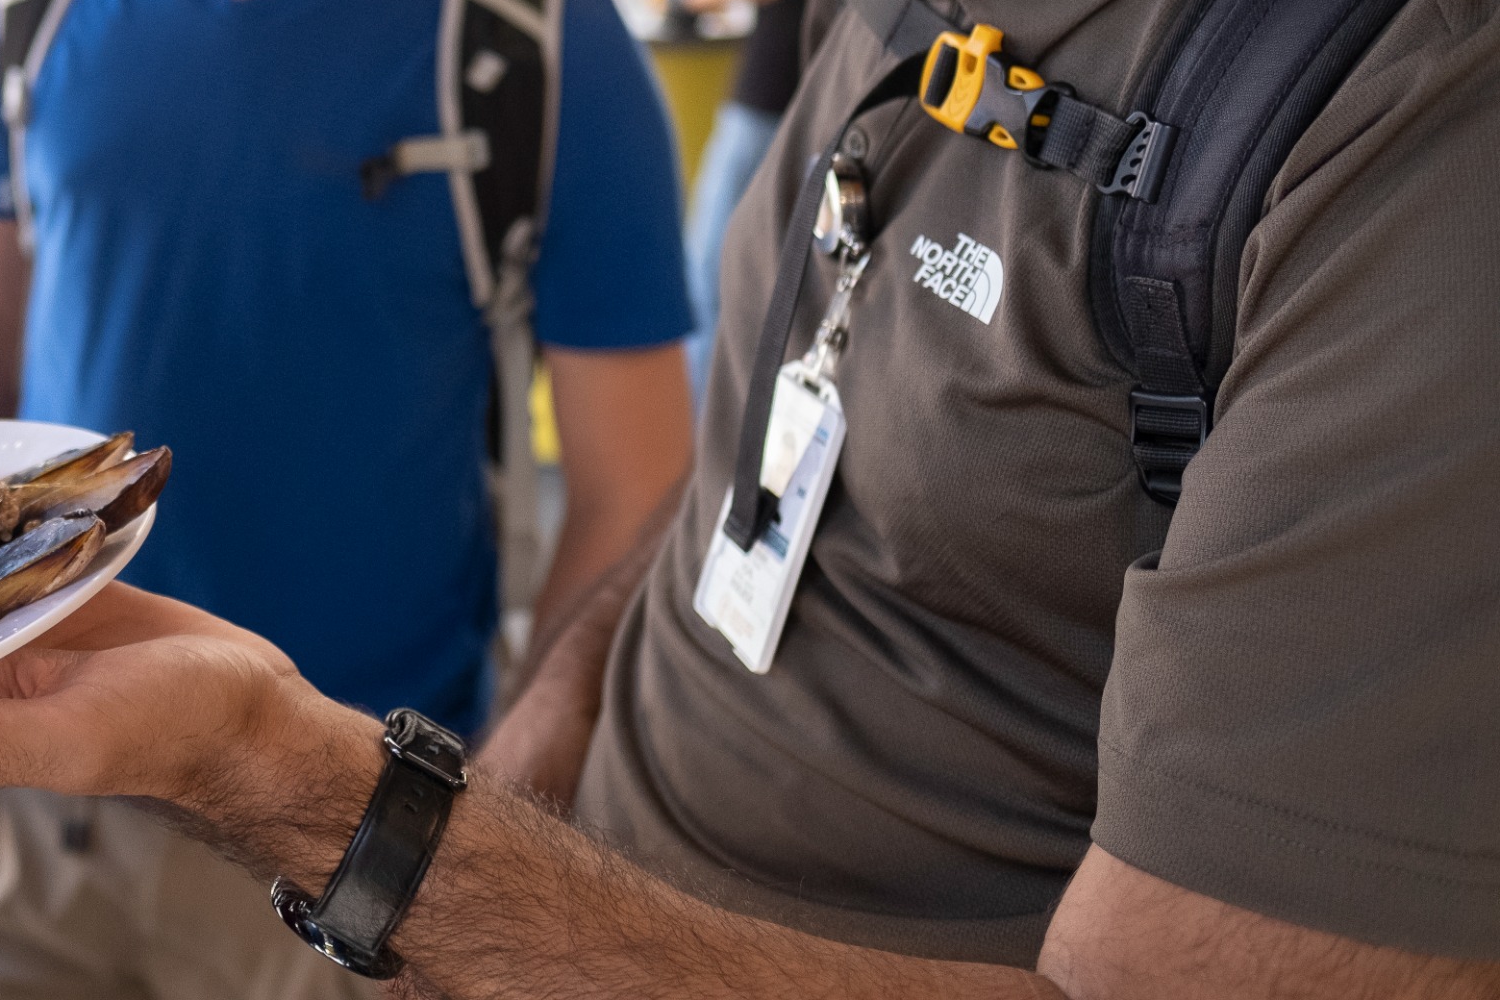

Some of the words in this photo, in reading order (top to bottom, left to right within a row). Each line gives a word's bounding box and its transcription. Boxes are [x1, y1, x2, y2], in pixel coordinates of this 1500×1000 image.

[909, 234, 983, 289] NORTH
[953, 232, 991, 270] THE
[913, 263, 970, 308] FACE
